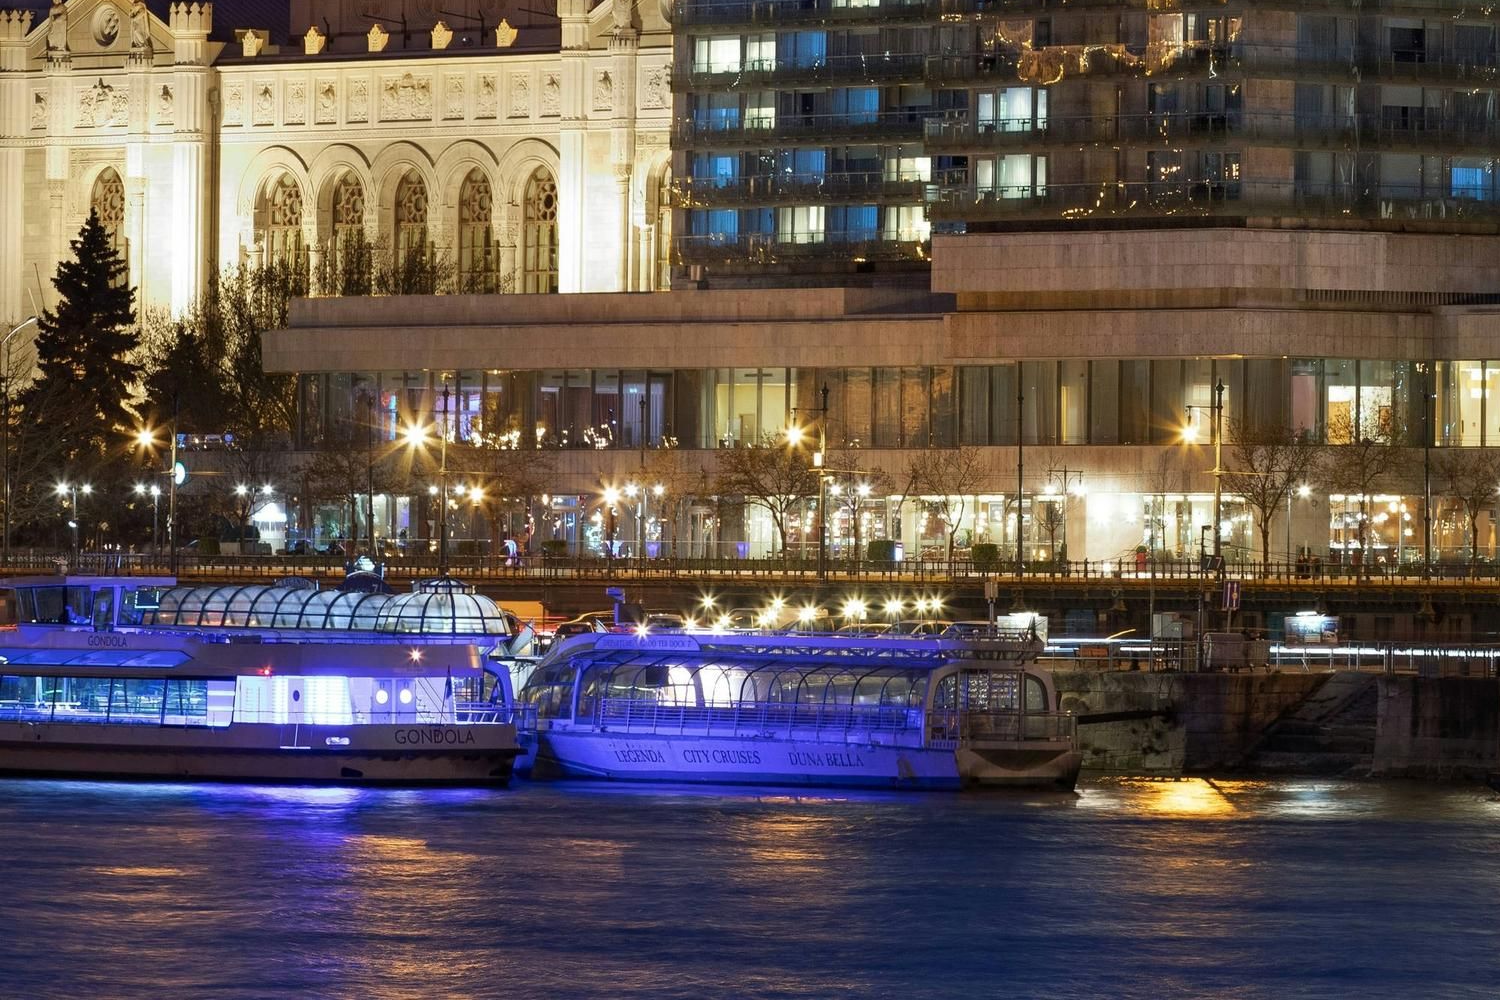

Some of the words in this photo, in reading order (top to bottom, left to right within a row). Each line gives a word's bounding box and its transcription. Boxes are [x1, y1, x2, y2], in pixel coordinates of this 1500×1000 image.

[88, 636, 129, 647] GONDOLA
[394, 729, 475, 744] GONDOLA
[614, 749, 666, 763] LEGENDA
[683, 749, 710, 764] CITY
[712, 749, 762, 765] CRUISES
[788, 751, 824, 766] DUNA
[825, 752, 865, 767] BELLA
